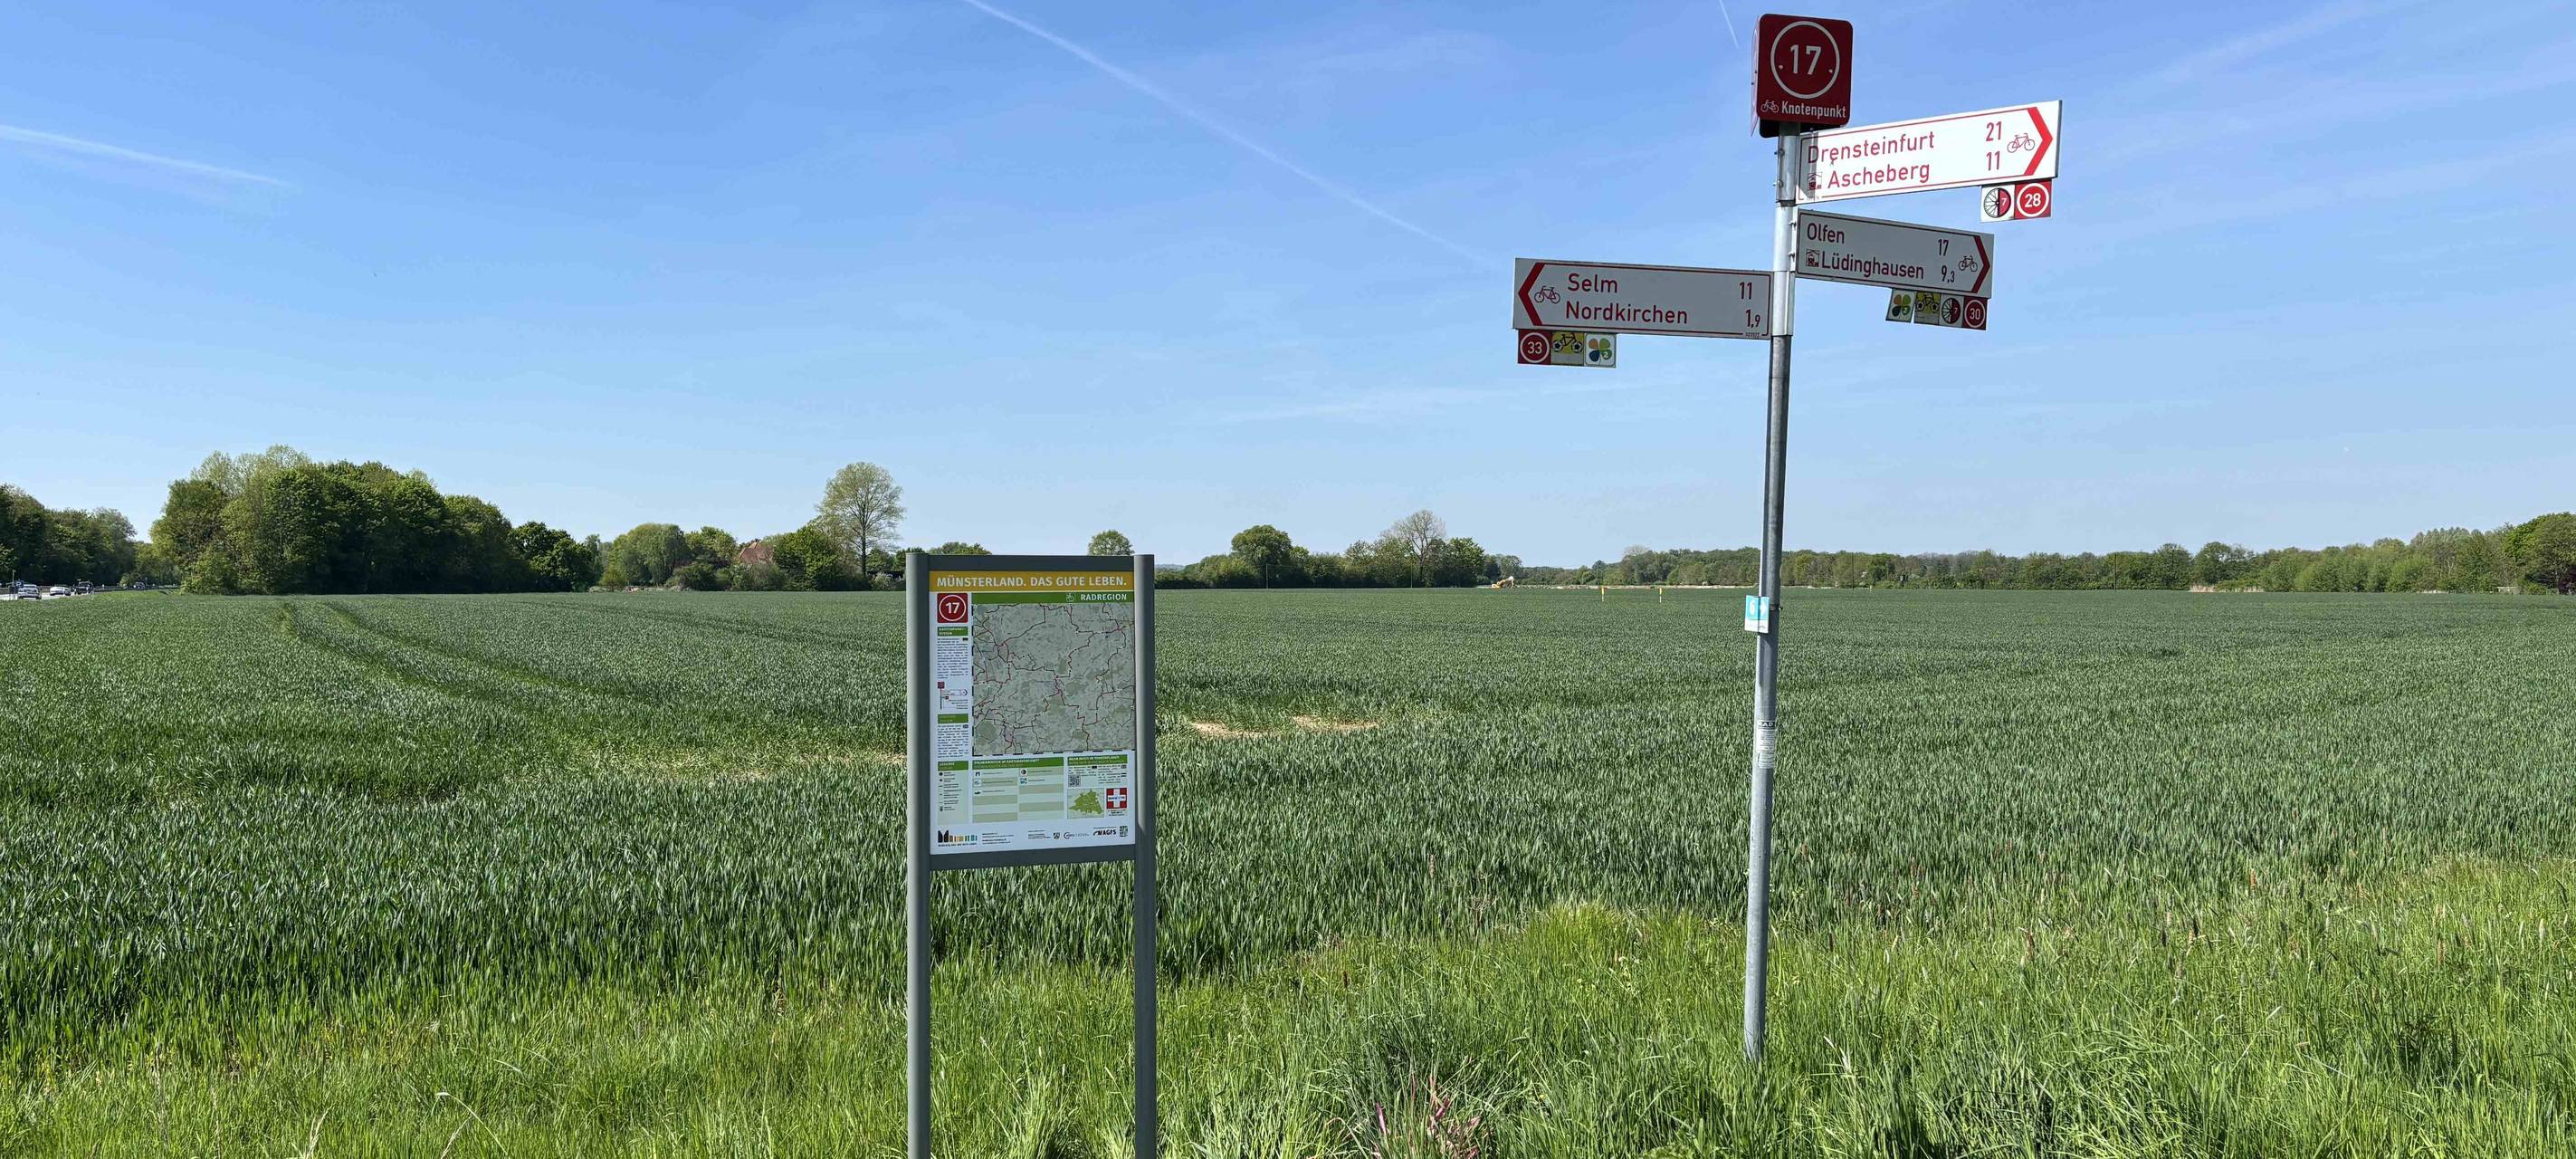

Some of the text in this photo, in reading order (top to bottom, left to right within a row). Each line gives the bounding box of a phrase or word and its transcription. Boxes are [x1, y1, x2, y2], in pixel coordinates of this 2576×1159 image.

[1790, 44, 1822, 75] 17
[1781, 100, 1846, 120] Knotenpunkt
[1808, 121, 2003, 164] Drensteinfurt 21
[1827, 150, 2000, 189] Ascheberg 11
[2000, 197, 2007, 206] 7
[2024, 193, 2041, 208] 28
[1807, 222, 1950, 256] Olfen 17
[1821, 250, 1924, 280] Lüdinghausen
[1567, 273, 1753, 300] Selm 11
[1565, 301, 1688, 324] Nordkirchen
[1969, 308, 1981, 321] 30
[1527, 341, 1542, 355] 33
[937, 574, 1127, 588] MÜNSTERLAND. DAS GUTE LEBEN.
[1080, 593, 1127, 601] RADREGION
[945, 602, 960, 614] 17
